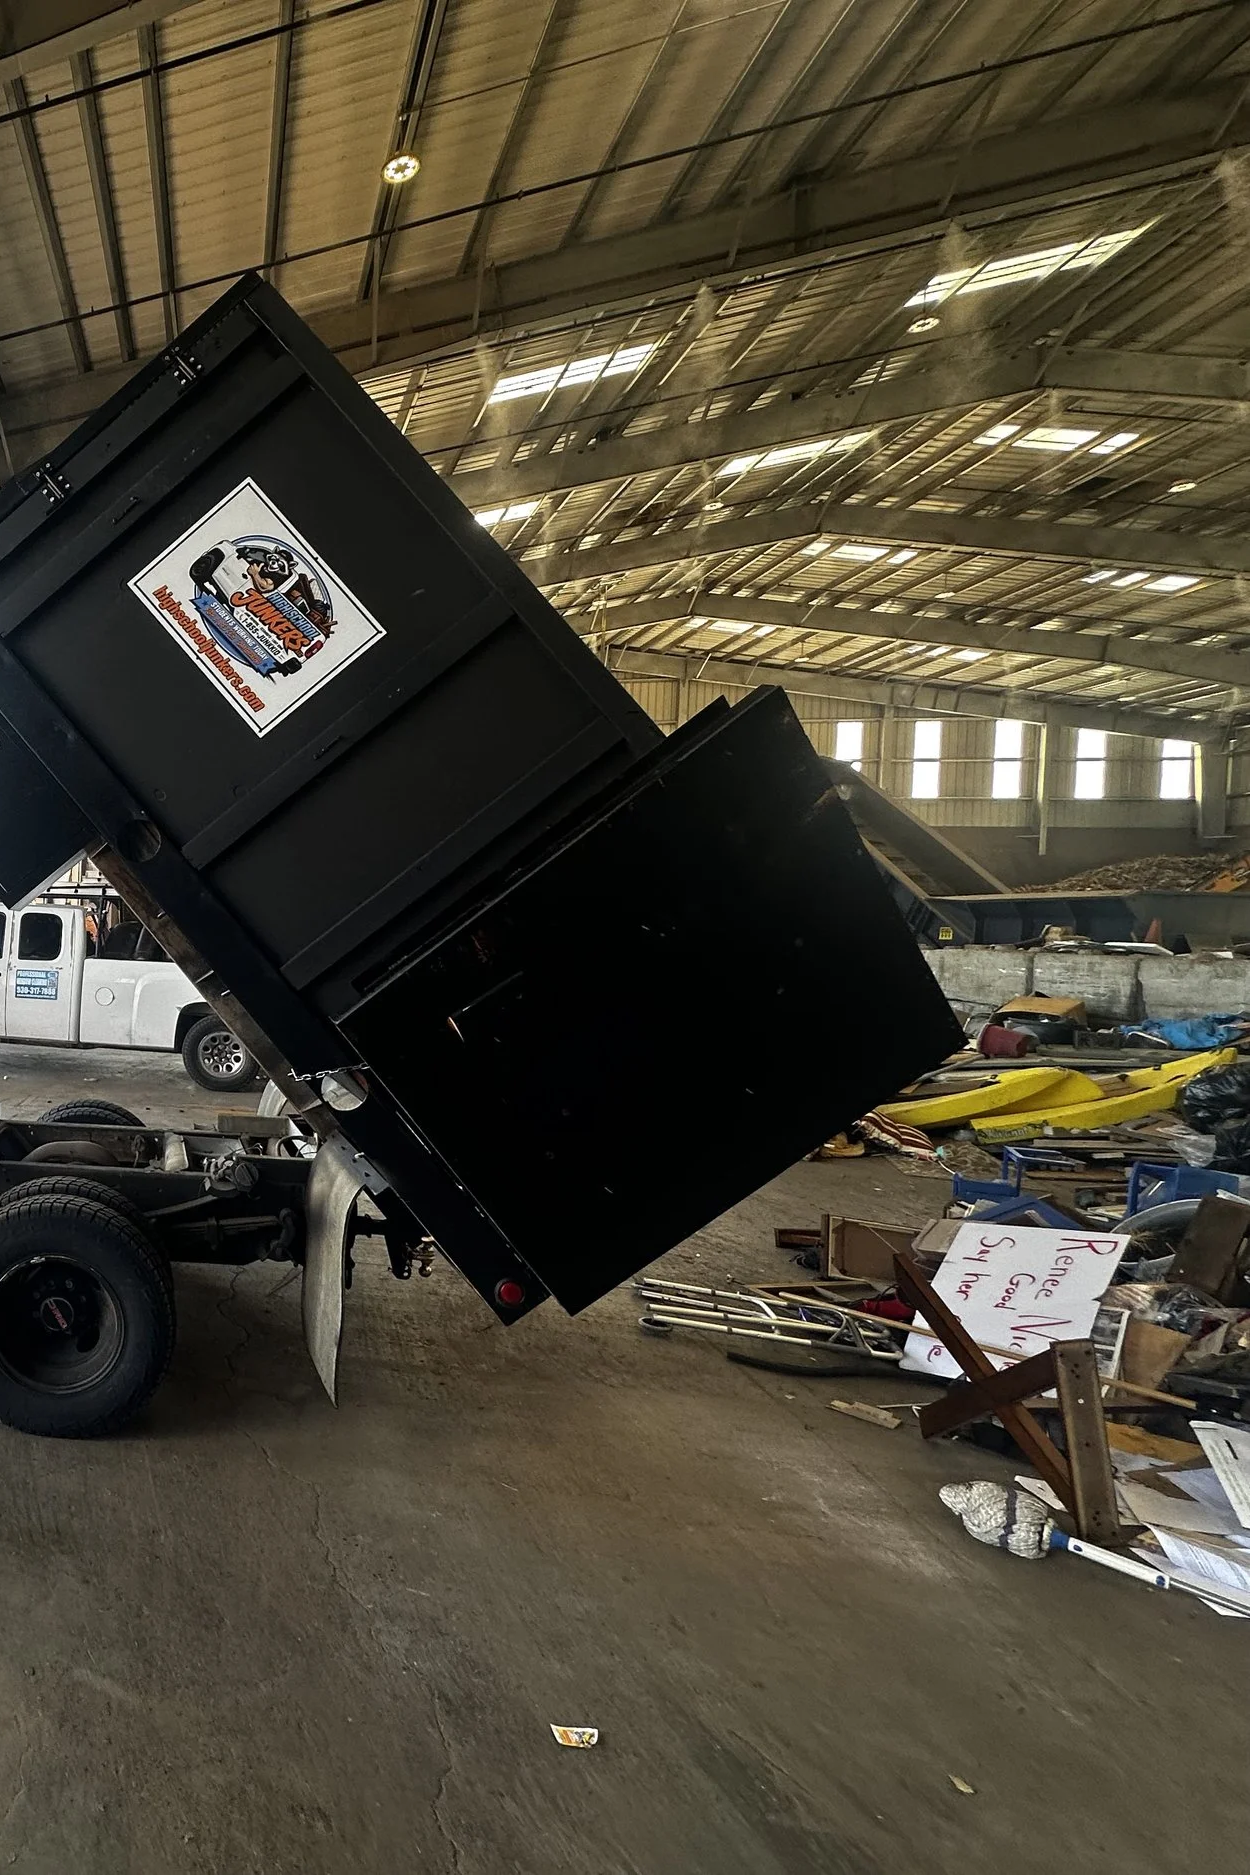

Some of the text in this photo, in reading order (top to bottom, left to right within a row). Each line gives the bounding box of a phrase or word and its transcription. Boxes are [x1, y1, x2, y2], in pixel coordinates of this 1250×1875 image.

[230, 588, 311, 655] JUNKERS
[267, 591, 294, 615] HIGH
[286, 609, 322, 642] SCHOOL
[152, 585, 265, 712] highschooljunkers.com
[955, 1236, 1016, 1301] Say her
[993, 1273, 1037, 1310] Good
[1034, 1238, 1119, 1300] Renee
